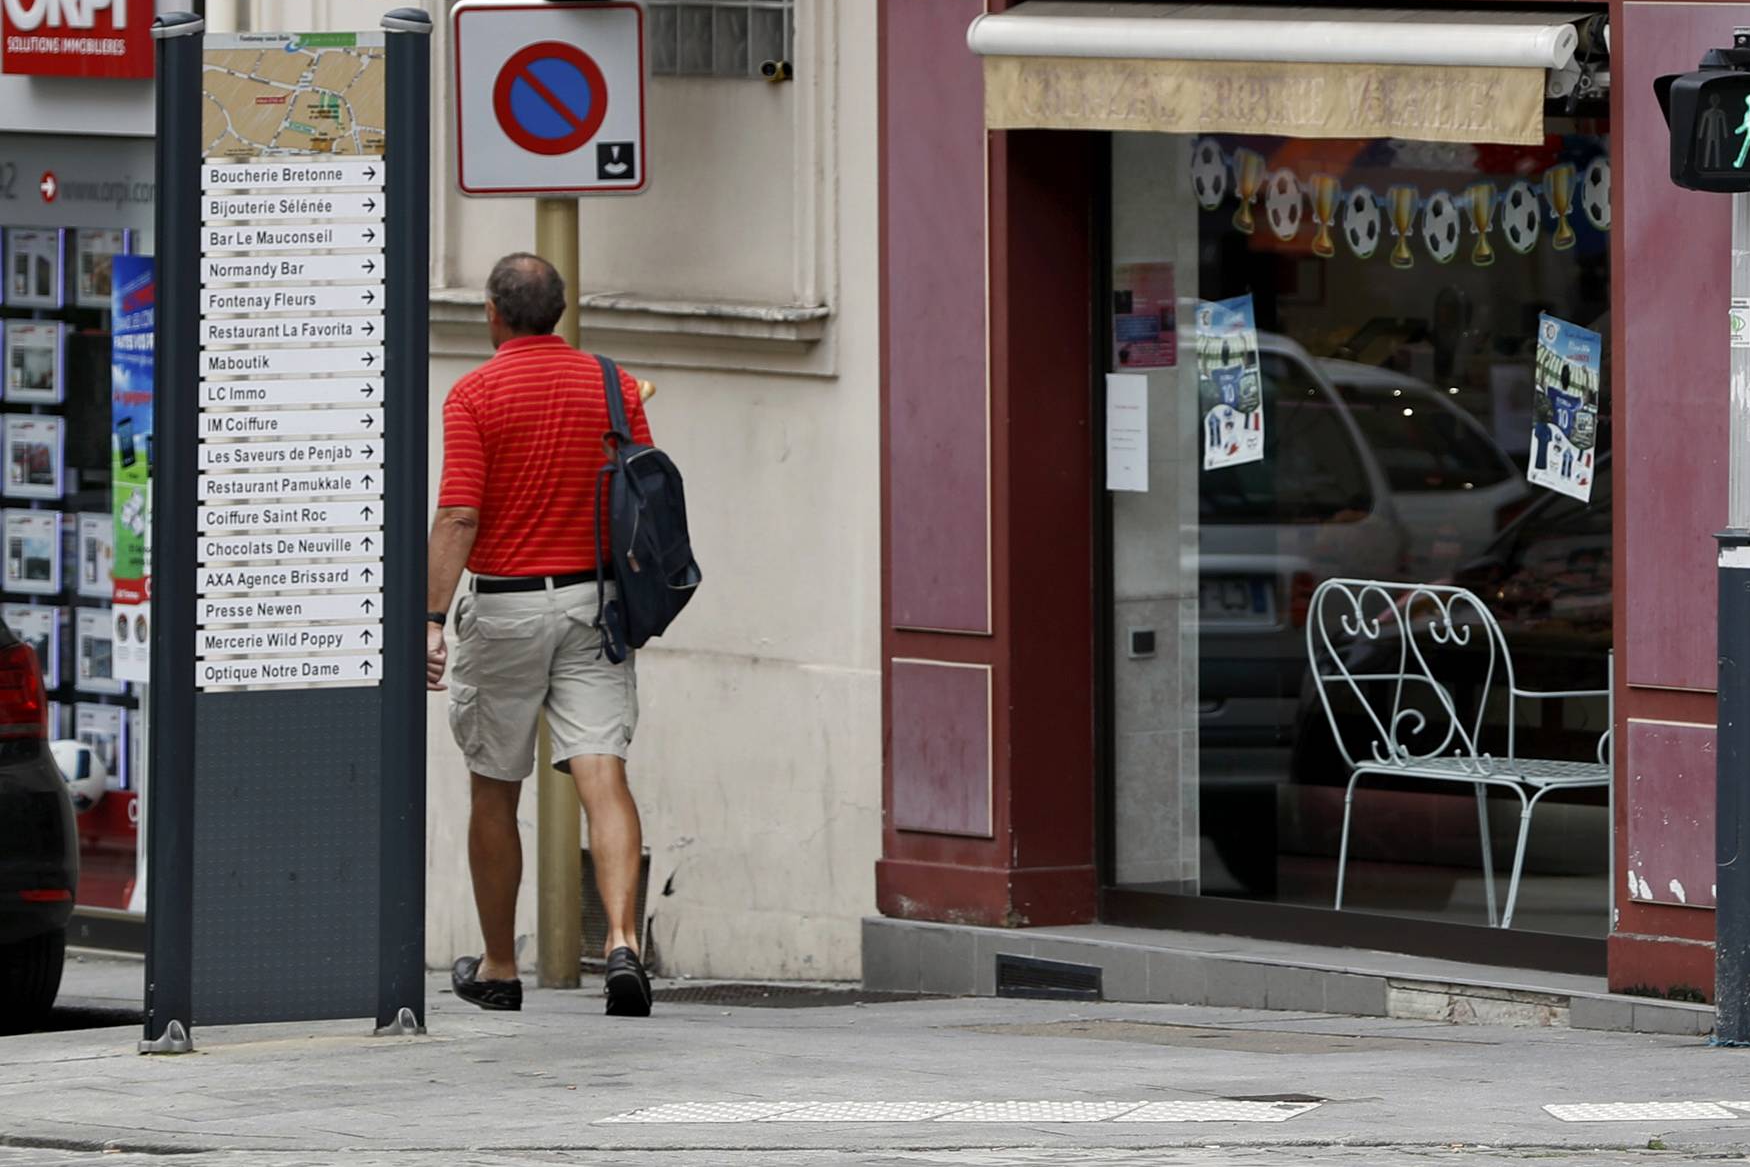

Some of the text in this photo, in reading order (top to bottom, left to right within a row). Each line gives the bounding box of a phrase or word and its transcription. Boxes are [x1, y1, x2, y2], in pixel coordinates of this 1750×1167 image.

[7, 36, 60, 53] SOLUTIONS
[210, 167, 343, 184] Boucherie Bretonne
[210, 198, 332, 218] Bijouterie Sélénée
[210, 230, 333, 245] Bar Le Mauconseil
[210, 261, 304, 279] Normandy Bar
[209, 292, 316, 310] Fontenay Fleurs
[209, 322, 353, 339] Restaurant La Favorita
[209, 355, 270, 370] Maboutik
[208, 387, 266, 401] LC Immo
[1222, 385, 1235, 403] 10
[208, 416, 278, 432] IM Coiffure
[1557, 408, 1569, 429] 10
[207, 445, 352, 463] Les Saveurs de Penjab
[207, 476, 351, 494] Restaurant Pamukkale
[206, 508, 327, 526] Coiffure Saint Roc
[206, 538, 351, 556] Chocolats De Neuville
[206, 569, 349, 589] AXA Agence Brissard
[206, 602, 302, 617] Presse Newen
[205, 631, 343, 648] Mercerie Wild Poppy
[205, 662, 340, 683] Optique Notre Dame
